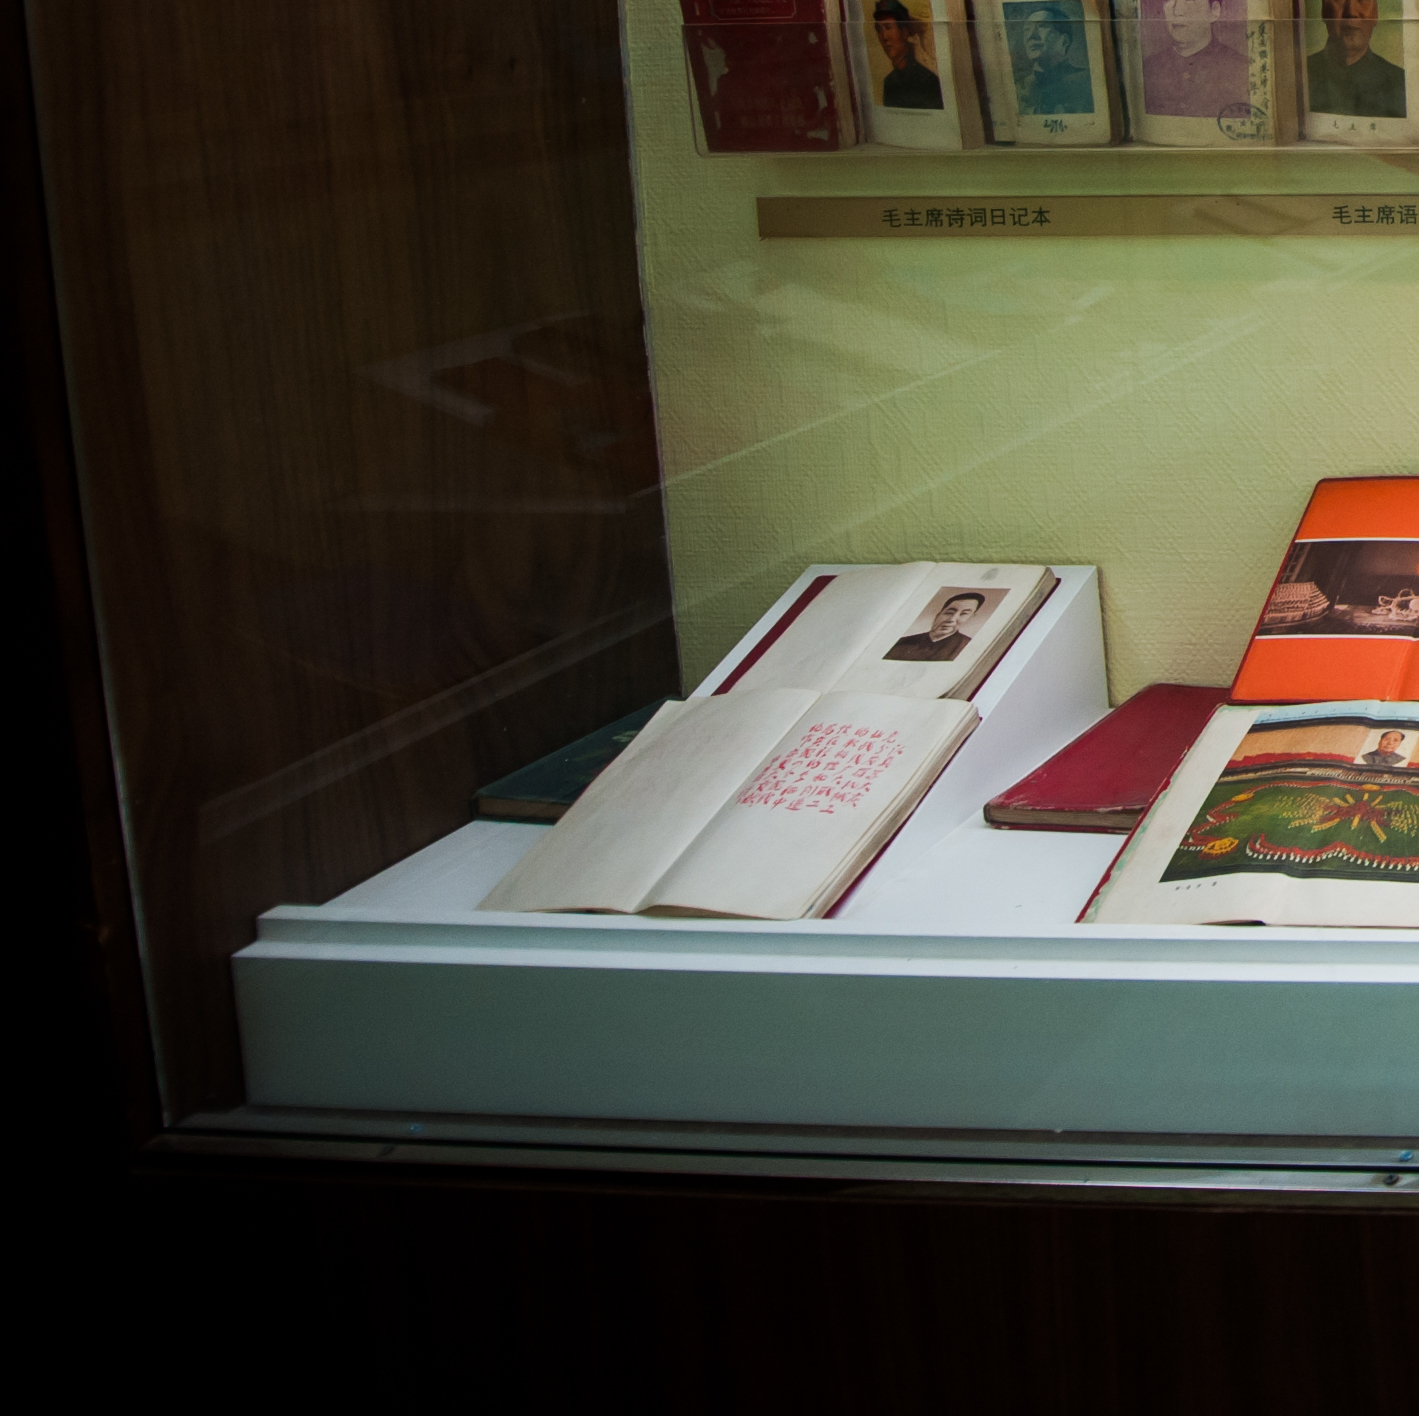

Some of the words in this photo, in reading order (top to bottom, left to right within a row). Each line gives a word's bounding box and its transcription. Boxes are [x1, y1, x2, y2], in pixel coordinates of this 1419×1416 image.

[881, 207, 1052, 228] 毛主席诗词日记本
